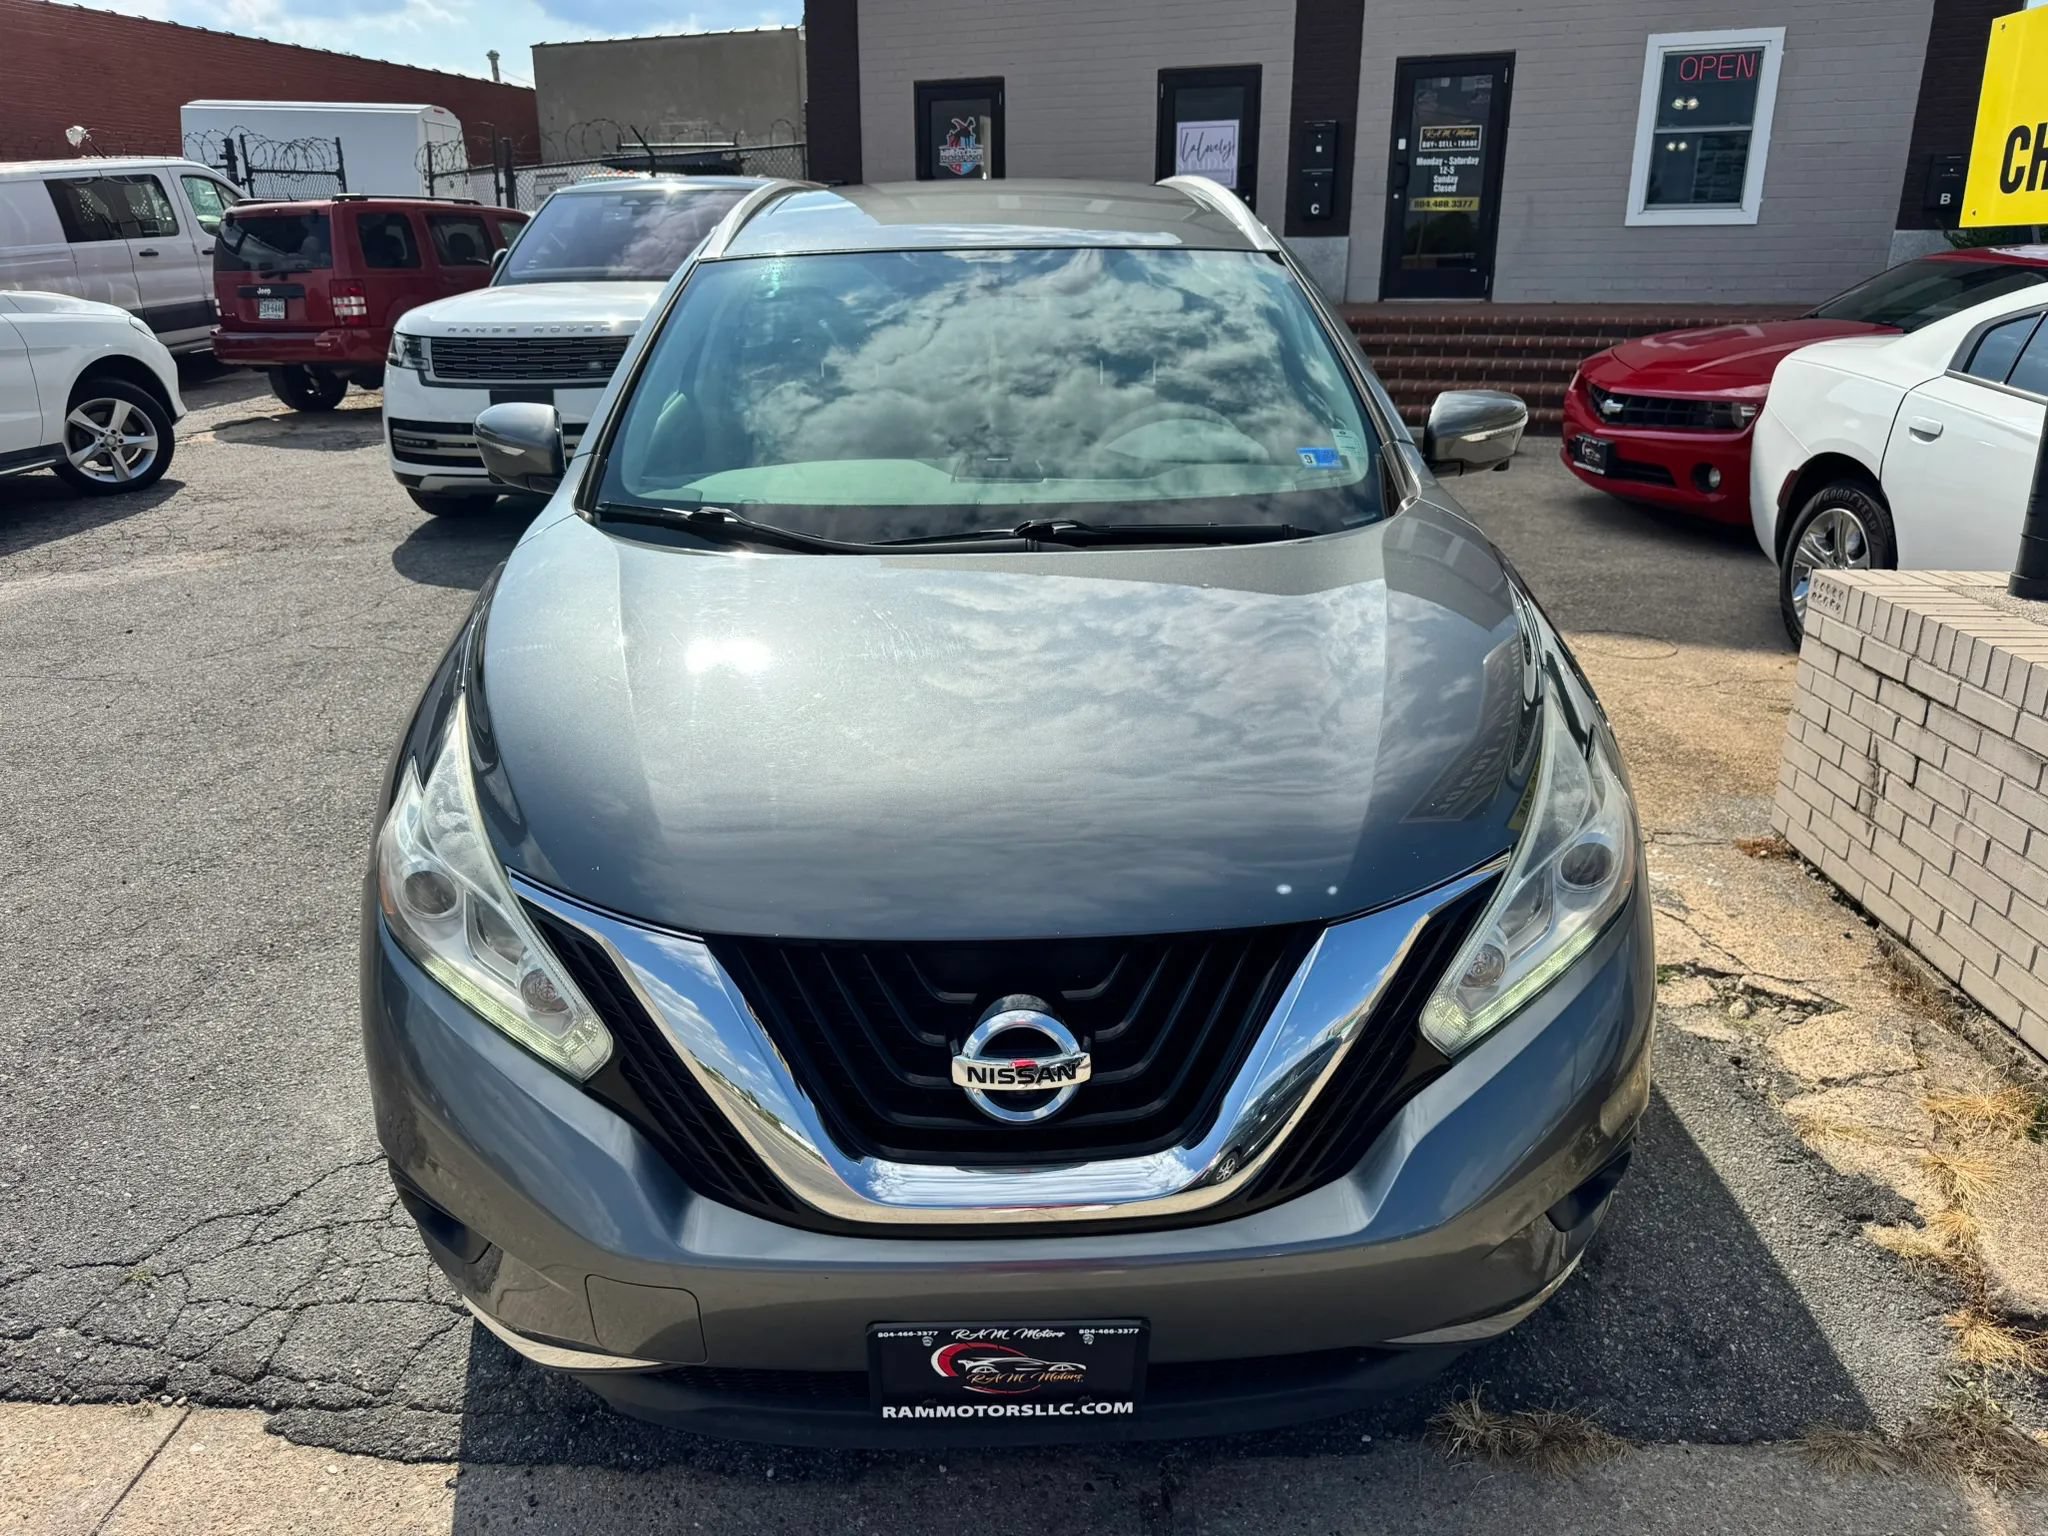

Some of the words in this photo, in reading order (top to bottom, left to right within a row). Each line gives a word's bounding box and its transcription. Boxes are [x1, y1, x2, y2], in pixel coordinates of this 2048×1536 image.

[1680, 53, 1756, 81] OPEN
[1416, 157, 1443, 166] Monday
[1448, 156, 1479, 166] Saturday
[1433, 175, 1458, 183] Sunday
[1433, 184, 1457, 192] Closed
[1940, 193, 1951, 205] B
[1311, 203, 1320, 215] C
[257, 287, 271, 296] Jeep
[533, 325, 612, 333] ROVER
[967, 1063, 1077, 1084] NISSAN
[1013, 1327, 1066, 1340] Motors
[1030, 1370, 1083, 1382] Motors
[882, 1401, 1134, 1419] RAMMOTORSLLC.COM
